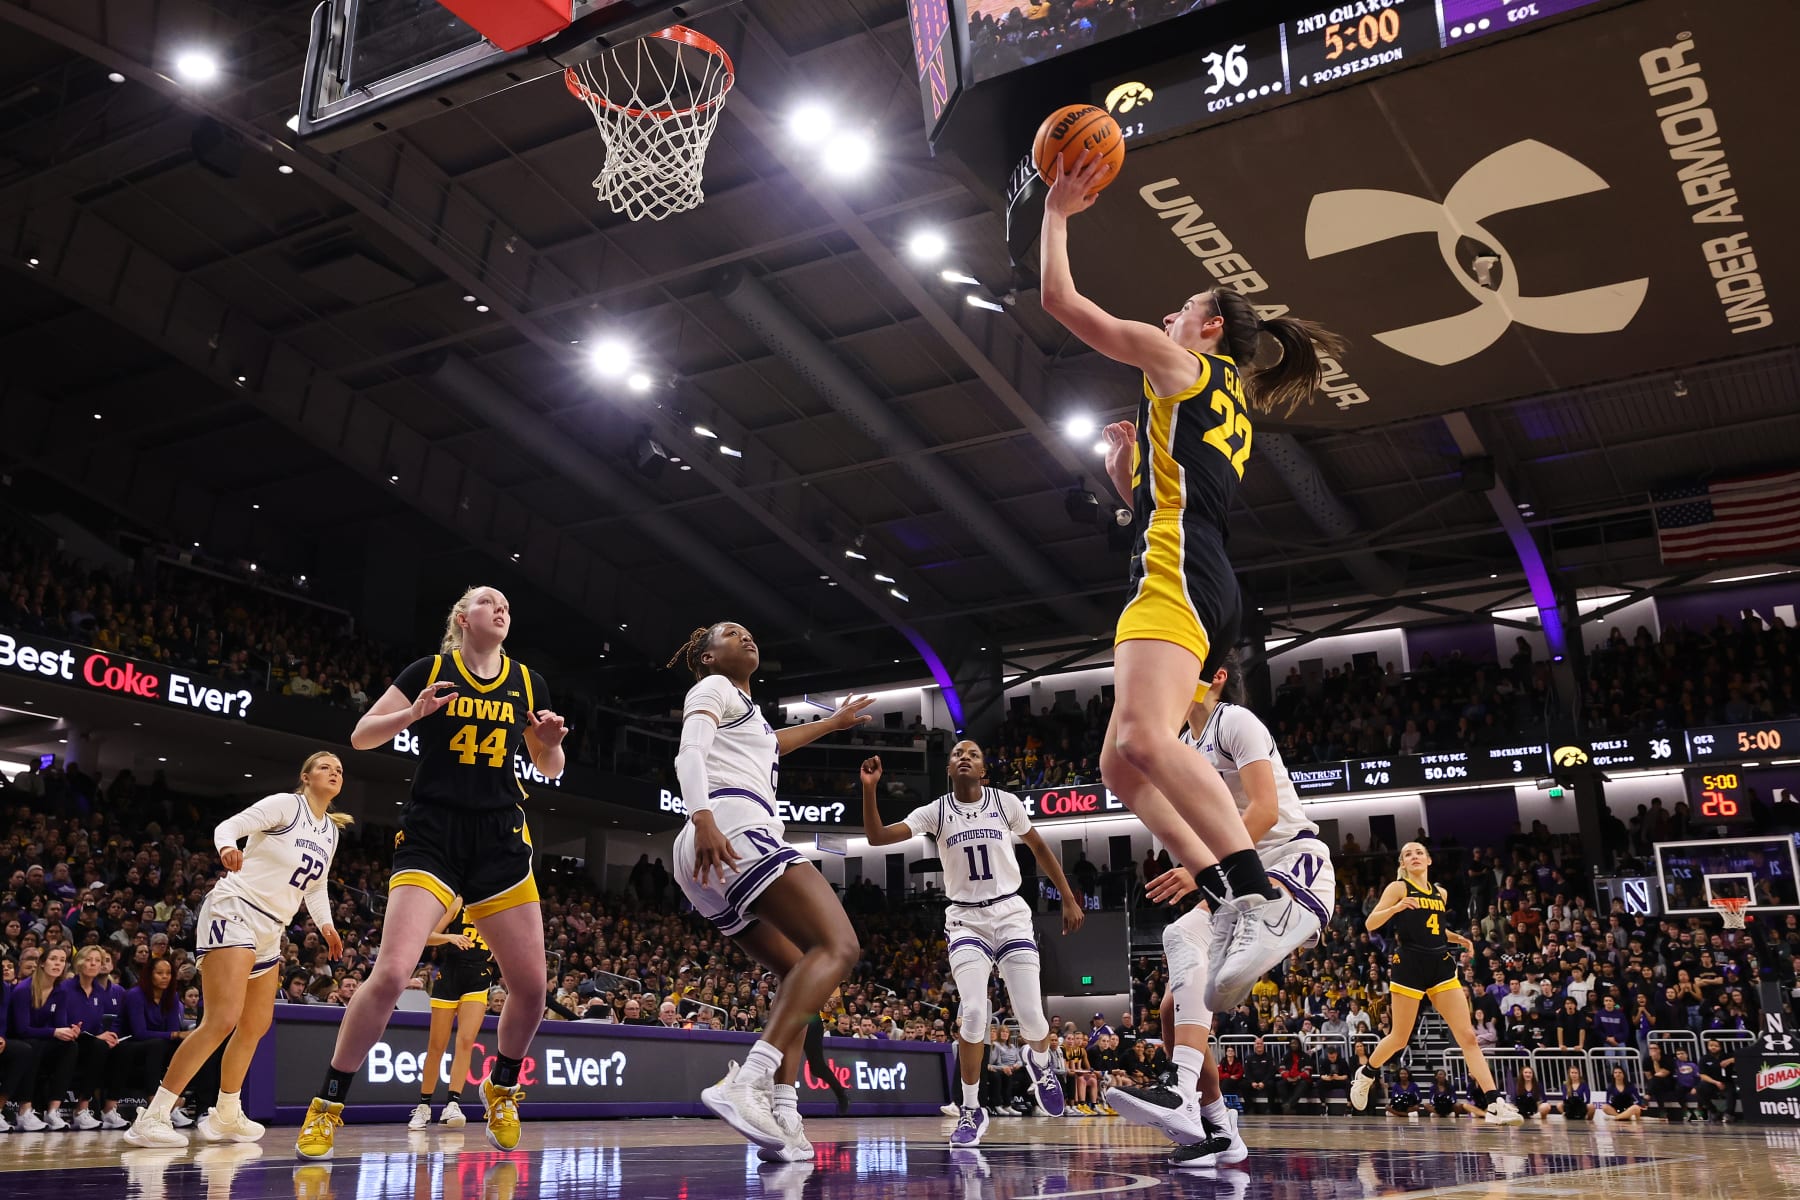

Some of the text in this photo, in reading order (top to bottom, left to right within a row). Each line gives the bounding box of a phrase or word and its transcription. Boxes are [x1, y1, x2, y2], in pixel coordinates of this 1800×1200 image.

[1297, 13, 1327, 35] 2ND
[1325, 8, 1400, 60] 5:00
[1202, 44, 1248, 95] 36
[1313, 48, 1404, 84] POSSESSION
[929, 45, 947, 119] N
[1137, 122, 1144, 135] 2
[1139, 177, 1269, 296] UNDER
[1701, 231, 1774, 334] UNDER
[1202, 389, 1253, 483] 22
[0, 633, 253, 717] Best Coke Ever?
[446, 696, 515, 724] IOWA
[393, 728, 420, 756] Be
[449, 725, 508, 768] 44
[1649, 739, 1671, 759] 36
[1737, 729, 1781, 752] 5:00
[1290, 769, 1342, 781] WINTRUST
[1364, 772, 1389, 785] 4/8
[1424, 766, 1467, 780] 50.0%
[1513, 761, 1522, 772] 3
[1703, 774, 1738, 790] 5:00
[660, 789, 845, 823] Bes Ever?
[1041, 790, 1098, 815] Coke
[1702, 791, 1737, 816] 26
[946, 828, 1003, 848] NORTHWESTERN
[288, 853, 324, 891] 22
[963, 844, 993, 881] 11
[1291, 852, 1324, 888] N
[1417, 897, 1446, 912] IOWA
[1622, 880, 1651, 914] N
[209, 919, 227, 945] N
[1426, 913, 1440, 935] 4
[1765, 1012, 1784, 1033] N
[465, 1042, 539, 1085] Coe
[545, 1048, 627, 1087] Ever?
[855, 1061, 907, 1090] Ever?
[1756, 1067, 1800, 1092] LIBMAN
[1759, 1097, 1800, 1120] meij
